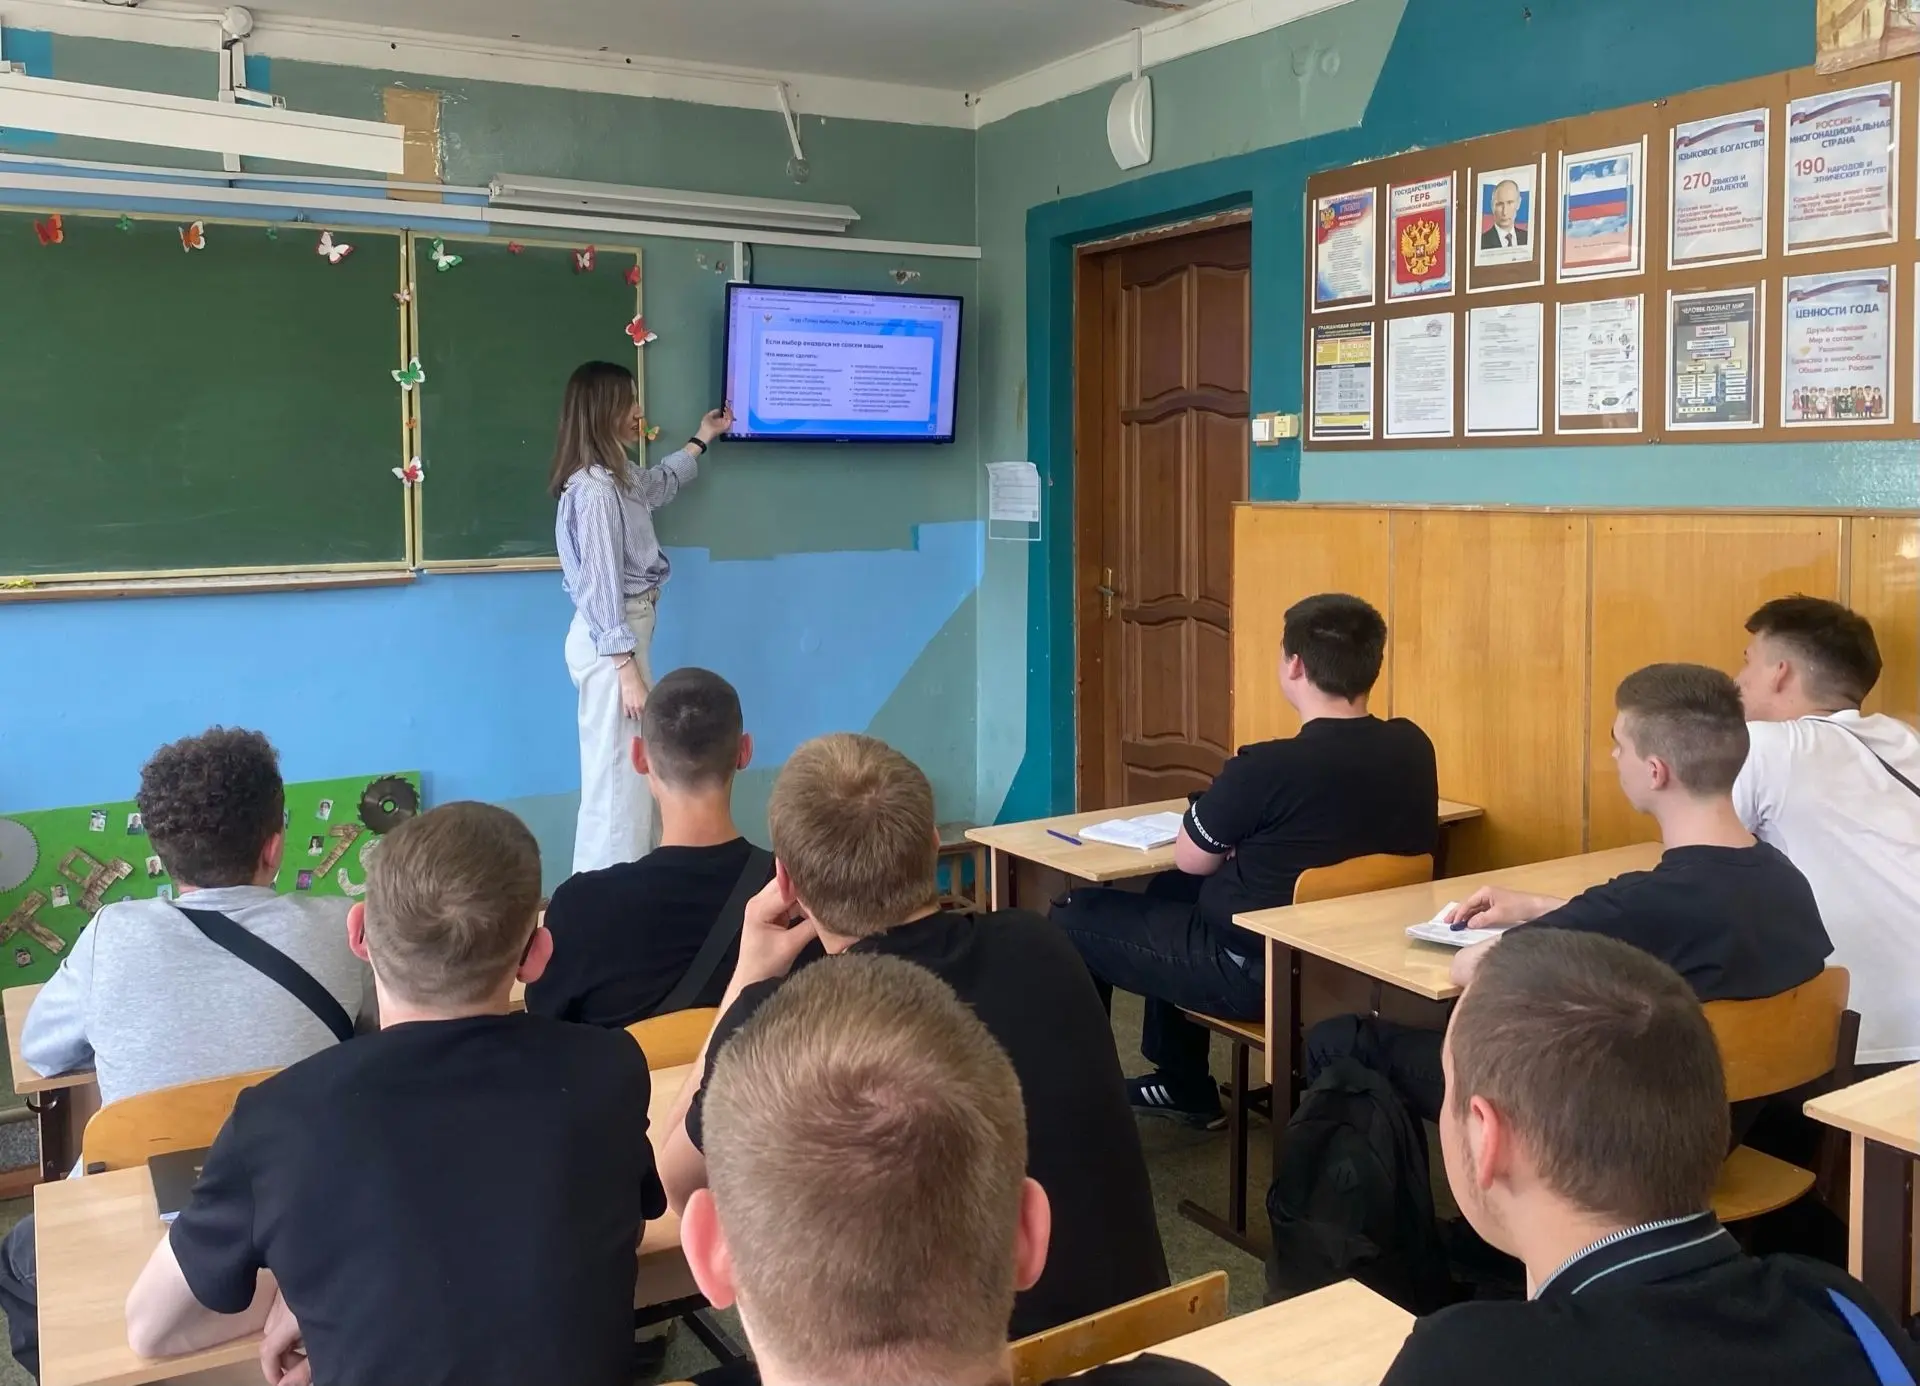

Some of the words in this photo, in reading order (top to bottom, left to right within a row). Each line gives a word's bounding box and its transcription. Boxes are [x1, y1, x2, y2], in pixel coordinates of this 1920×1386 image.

[1816, 116, 1853, 129] РОССИЯ
[1821, 136, 1856, 148] СТРАНА
[1678, 147, 1718, 161] ЯЗЫКОВОЕ
[1720, 139, 1765, 154] БОГАТСТВО
[1795, 156, 1825, 176] 190
[1827, 161, 1865, 173] НАРОДОВ
[1683, 171, 1711, 191] 270
[1712, 176, 1739, 186] ЯЗЫКОВ
[1813, 170, 1860, 183] ЭТНИЧЕСКИХ
[1862, 166, 1887, 177] ГРУПП
[1394, 180, 1448, 196] ГОСУДАРСТВЕННЫЙ
[1709, 182, 1749, 194] ДИАЛЕКТОВ
[1410, 192, 1431, 203] ГЕРБ
[1682, 306, 1706, 314] ЧЕЛОВЕК
[1706, 303, 1731, 312] ПОЗНАЕТ
[1795, 306, 1847, 319] ЦЕННОСТИ
[1850, 304, 1879, 314] ГОДА
[1806, 326, 1834, 335] Дружба
[781, 339, 802, 347] выбор
